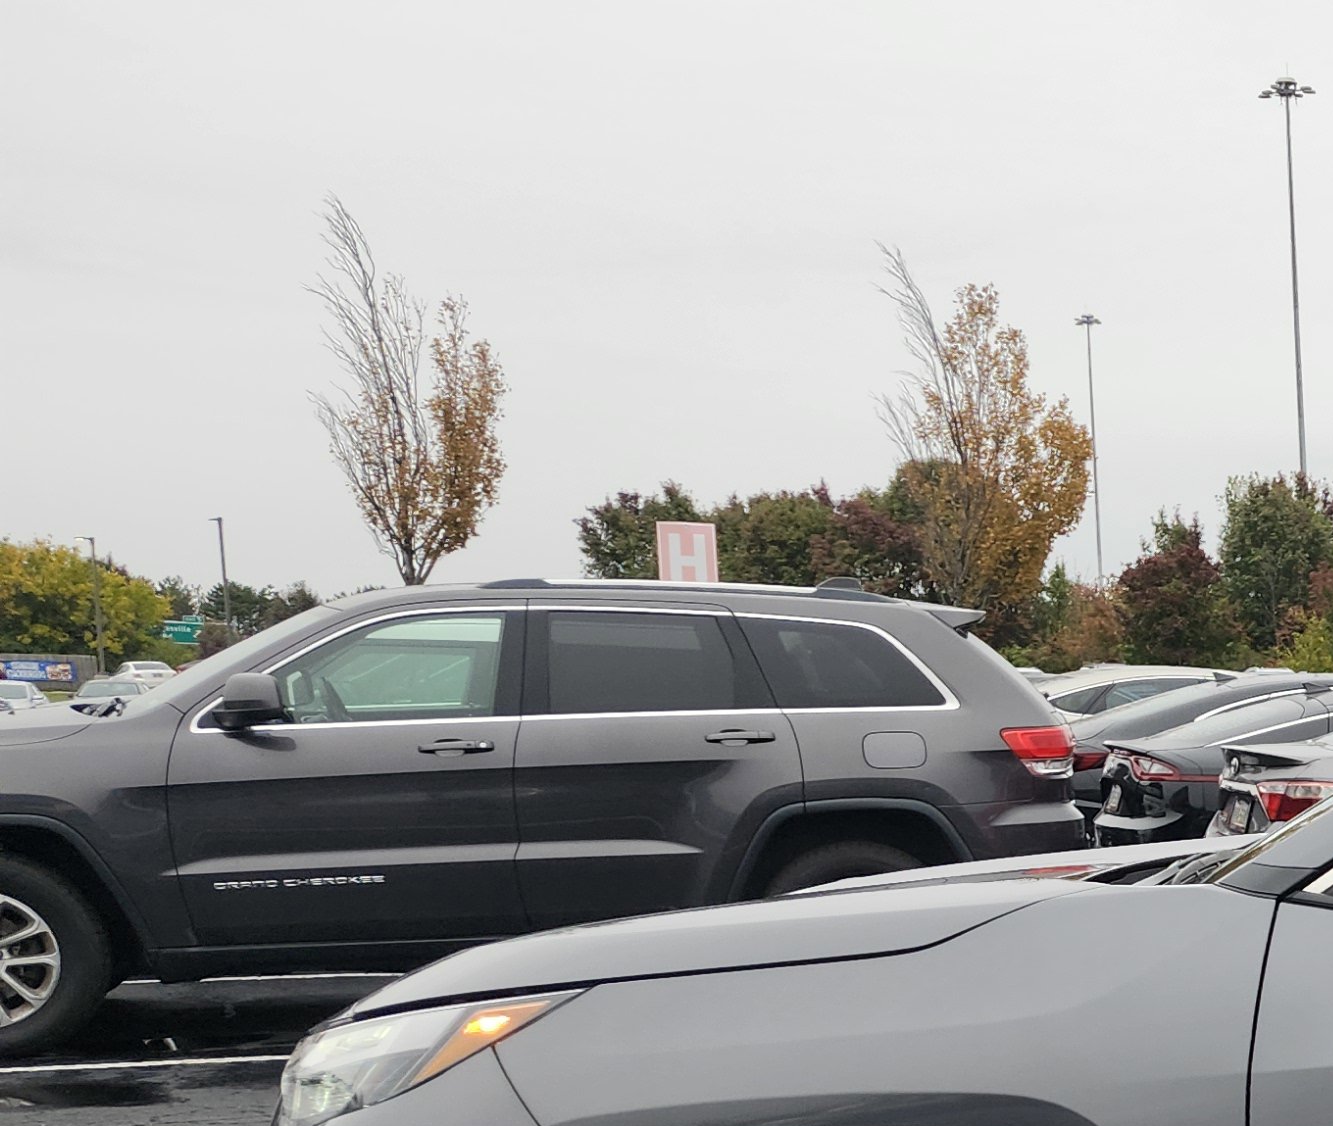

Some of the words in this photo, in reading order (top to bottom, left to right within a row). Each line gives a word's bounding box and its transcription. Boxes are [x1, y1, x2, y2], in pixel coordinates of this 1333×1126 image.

[668, 533, 707, 582] H
[213, 880, 278, 890] GRAND
[282, 875, 386, 887] CHEROKEE
